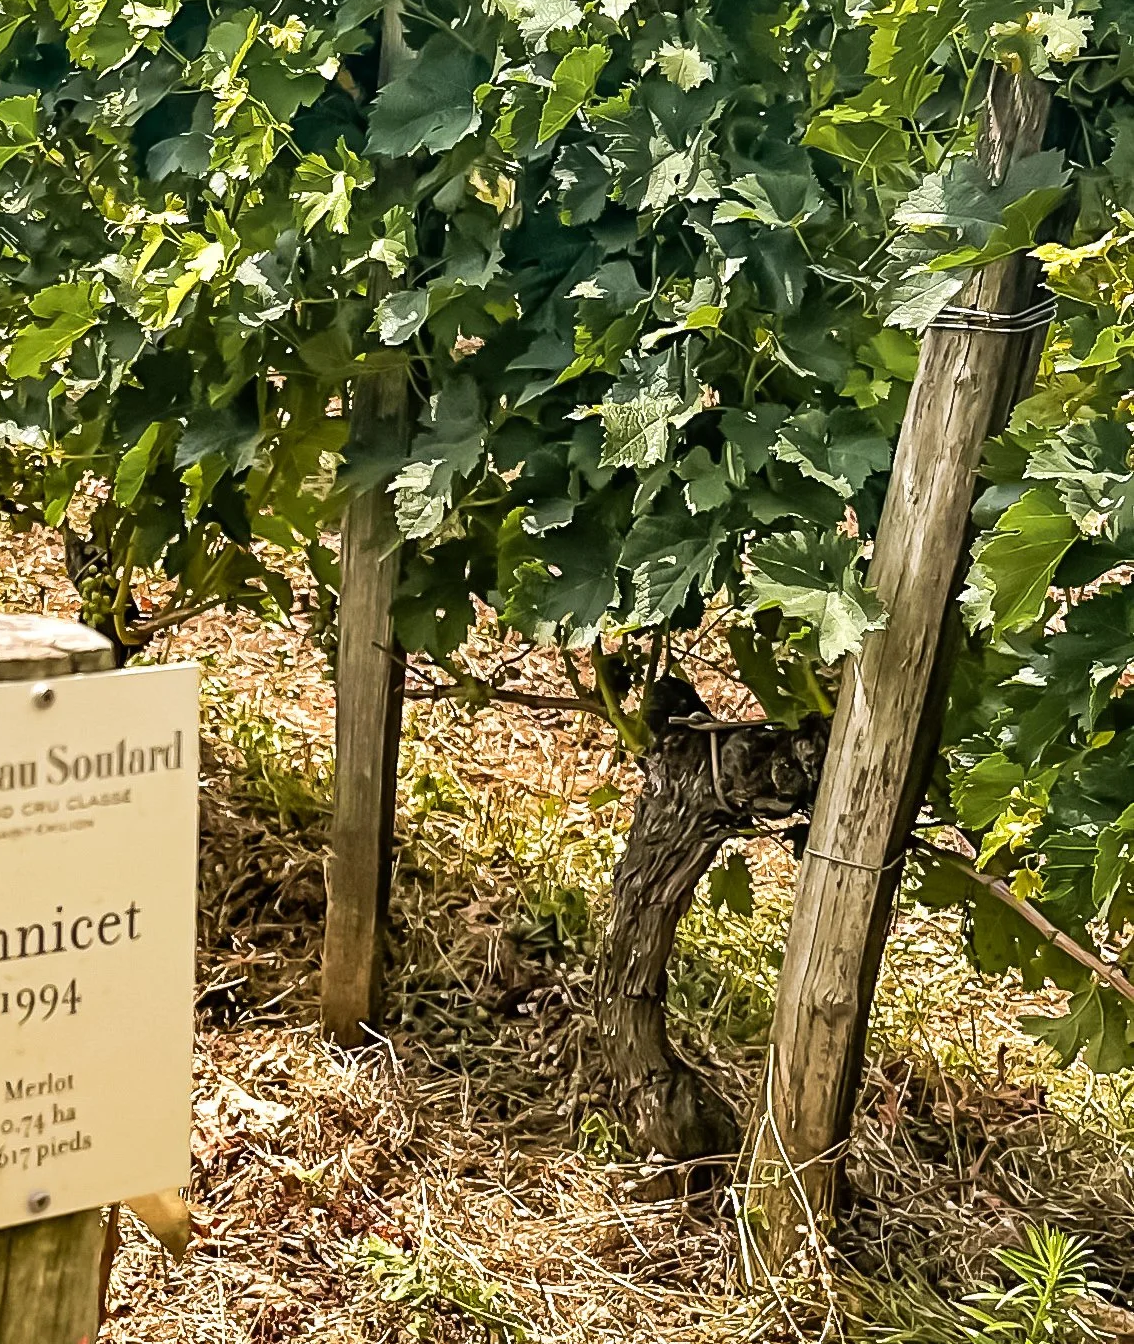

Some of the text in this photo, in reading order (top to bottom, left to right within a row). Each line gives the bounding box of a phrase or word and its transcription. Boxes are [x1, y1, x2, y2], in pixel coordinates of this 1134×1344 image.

[46, 730, 183, 786] Soutard
[20, 799, 59, 817] CRU
[66, 787, 131, 811] CLASSÉ
[1, 977, 82, 1027] 1994
[4, 1073, 74, 1102] Merlot
[52, 1103, 76, 1124] ha
[37, 1131, 92, 1166] pieds
